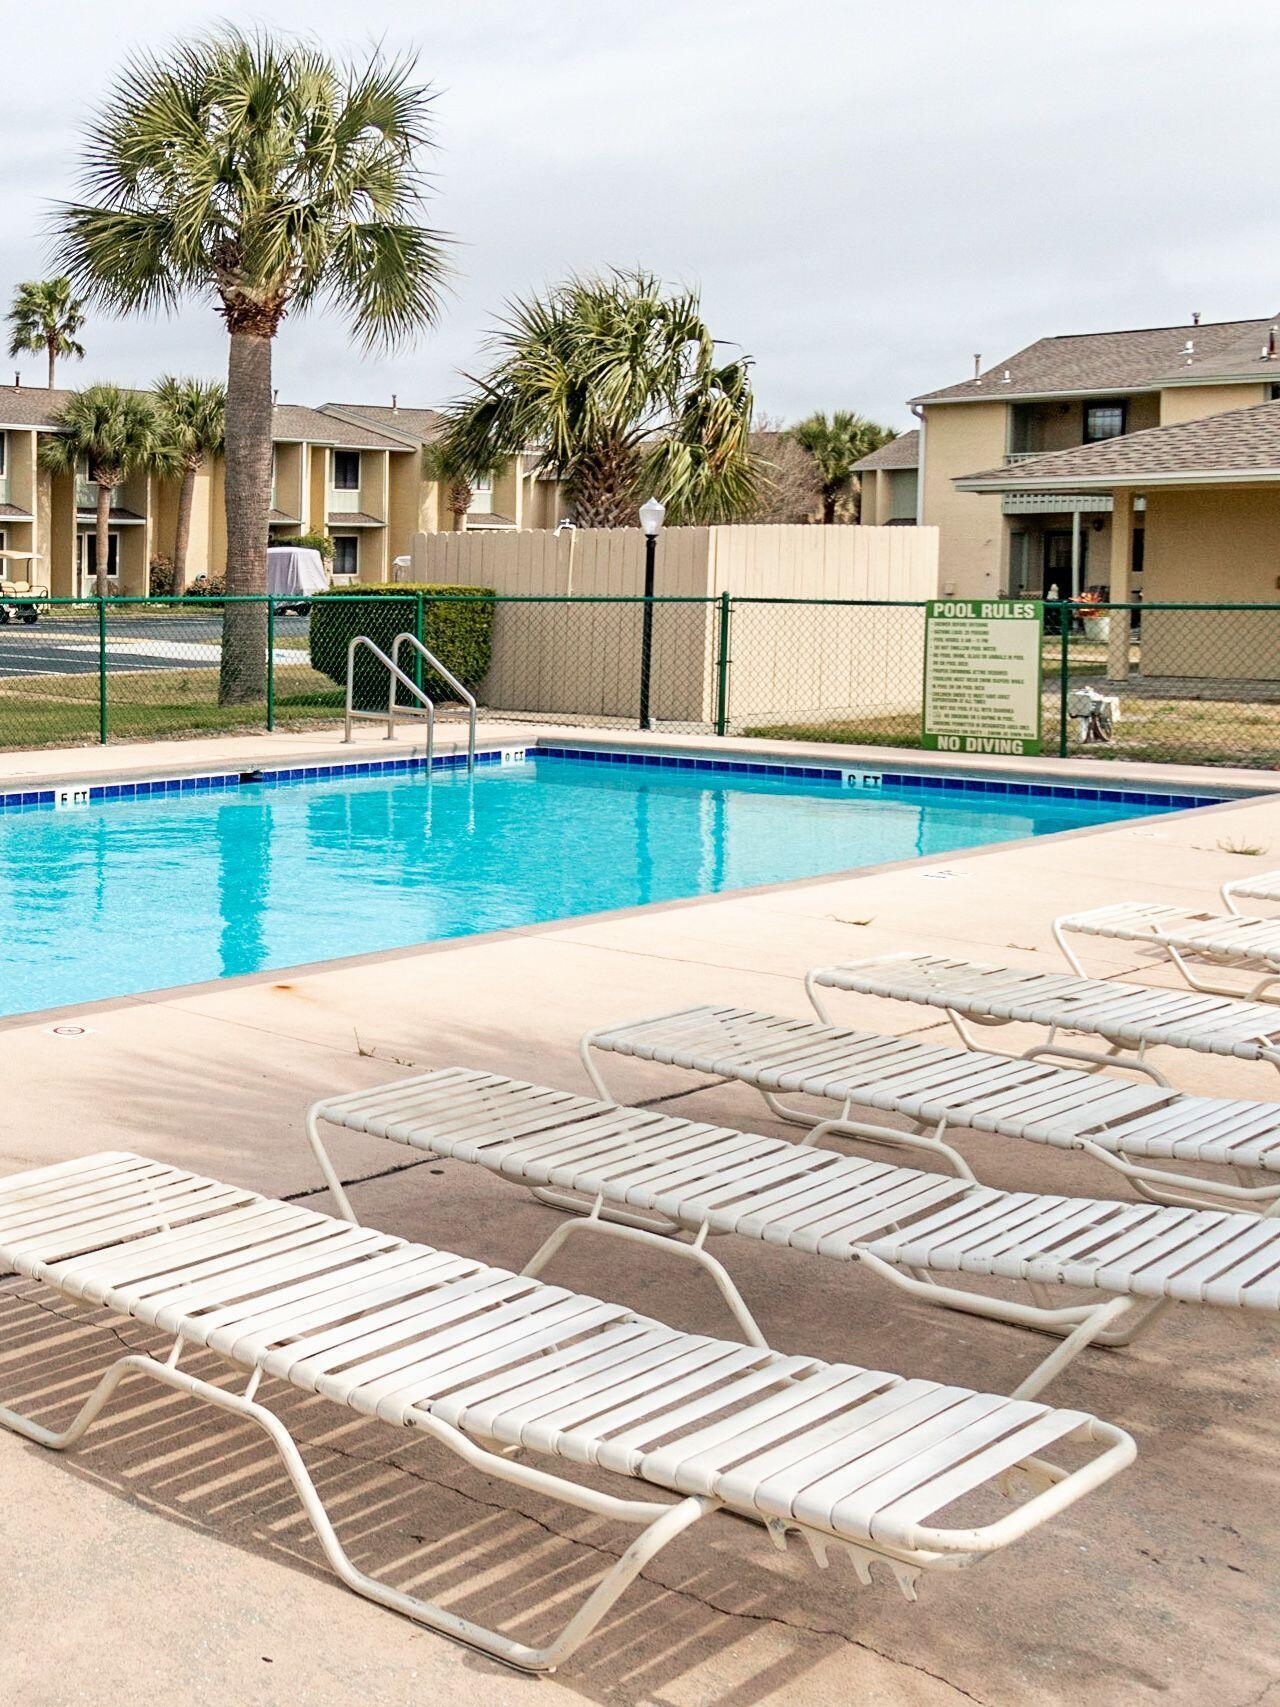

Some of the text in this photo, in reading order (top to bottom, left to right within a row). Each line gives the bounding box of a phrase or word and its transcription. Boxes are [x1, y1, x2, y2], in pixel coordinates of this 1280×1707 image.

[933, 603, 1035, 618] POOL RULES
[937, 736, 1024, 754] NO DIVING
